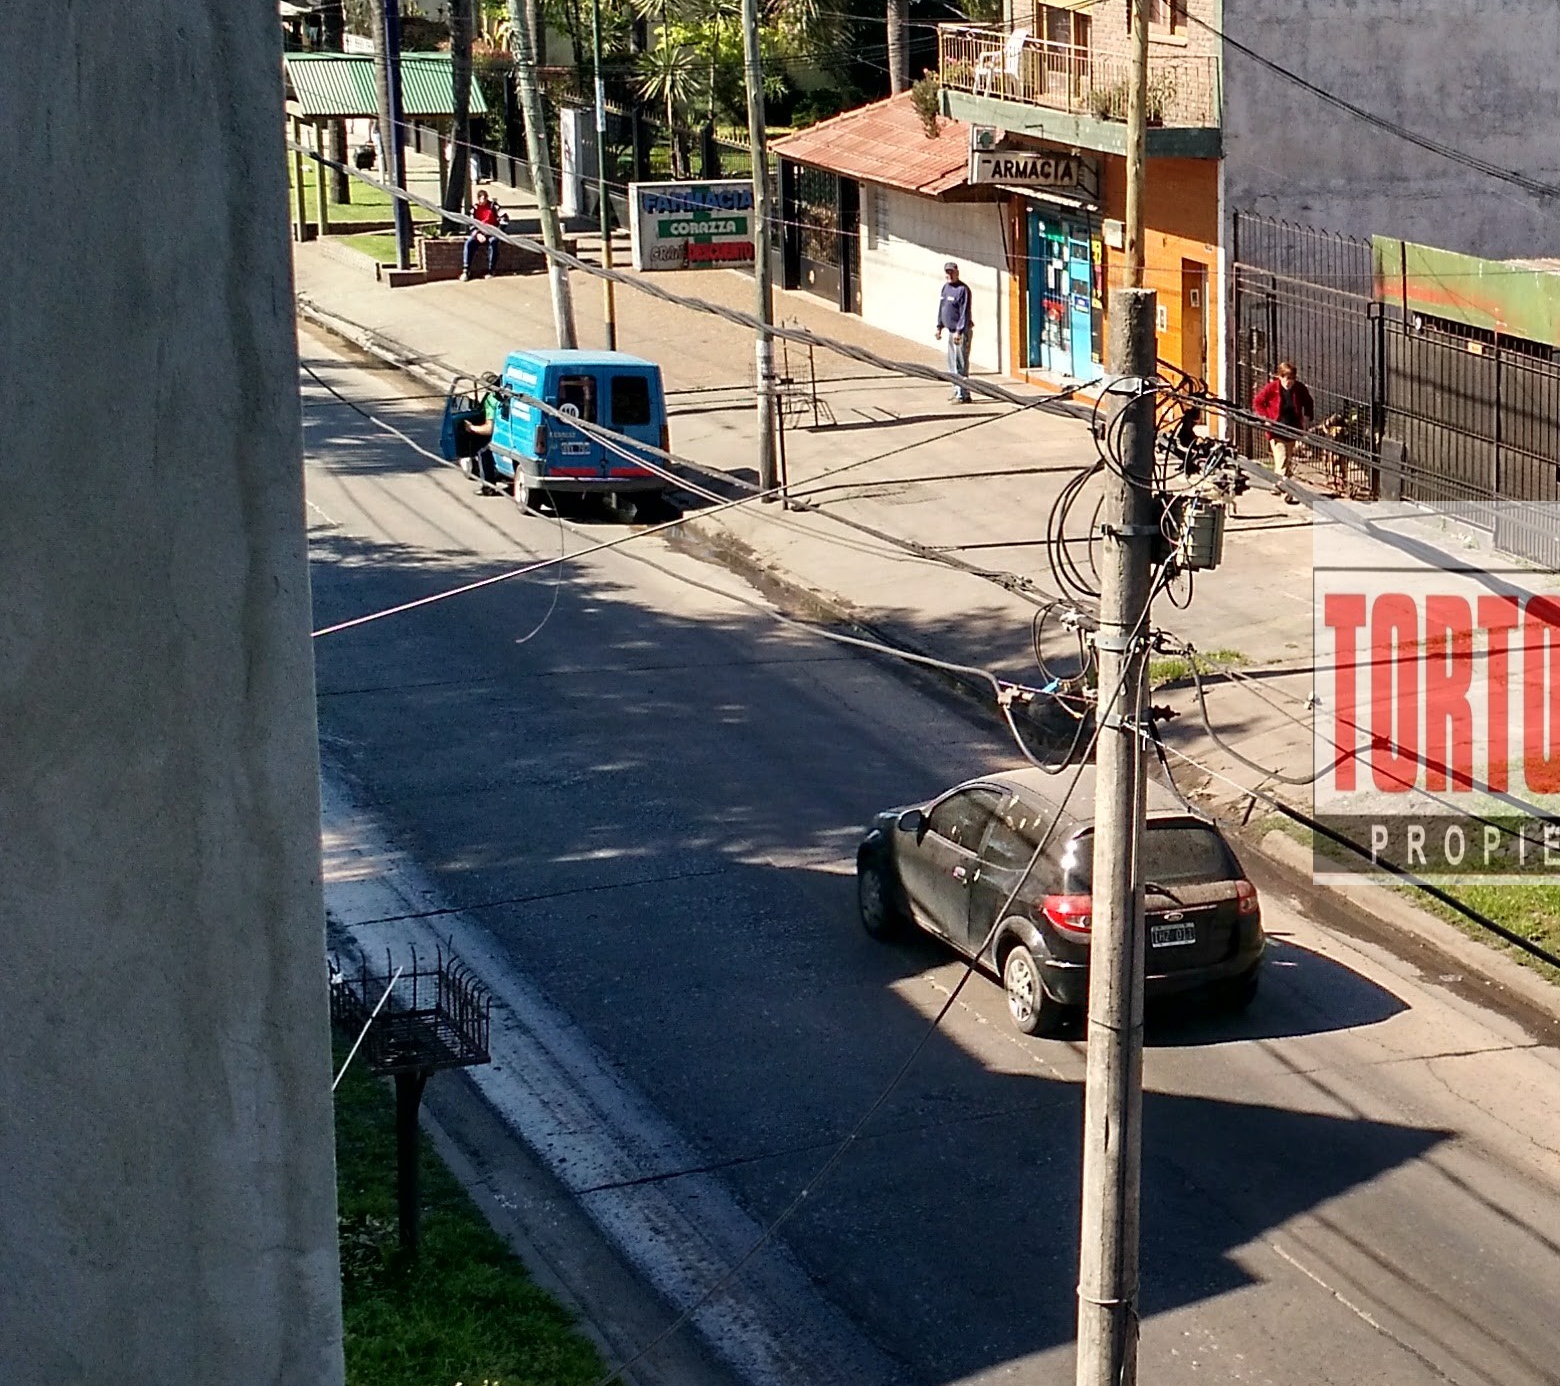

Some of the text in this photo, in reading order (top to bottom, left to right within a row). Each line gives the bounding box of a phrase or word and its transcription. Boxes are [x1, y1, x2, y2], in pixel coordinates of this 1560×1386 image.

[981, 159, 1074, 182] ARMACIA
[642, 189, 755, 214] FARMACIA
[669, 220, 737, 235] CORAZZA
